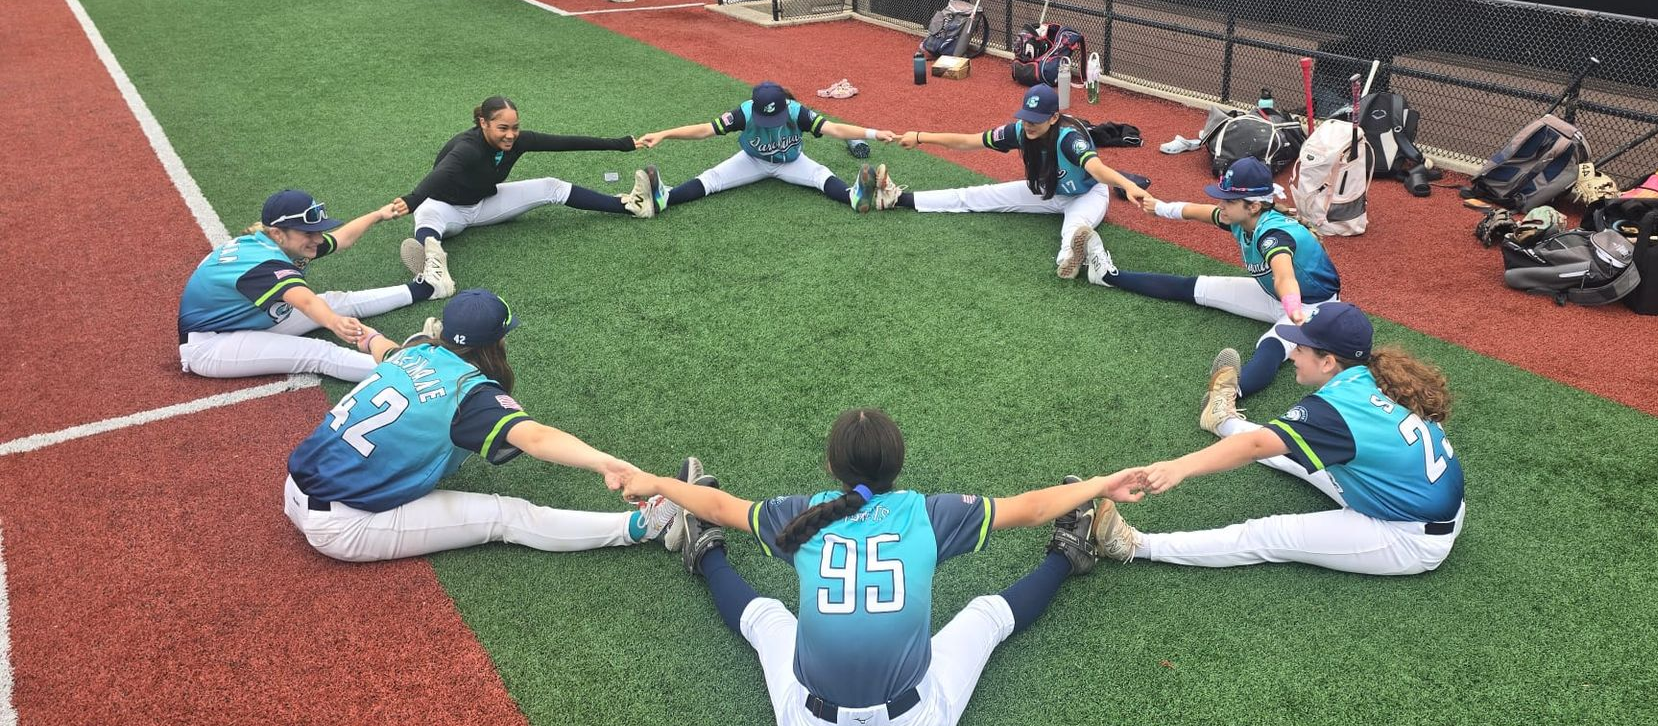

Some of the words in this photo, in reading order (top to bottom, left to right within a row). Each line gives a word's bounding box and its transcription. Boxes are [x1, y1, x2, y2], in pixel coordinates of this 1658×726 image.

[1582, 164, 1591, 177] 44
[1061, 180, 1077, 194] 17
[453, 334, 467, 346] 42
[328, 371, 410, 459] 42
[816, 532, 906, 615] 95
